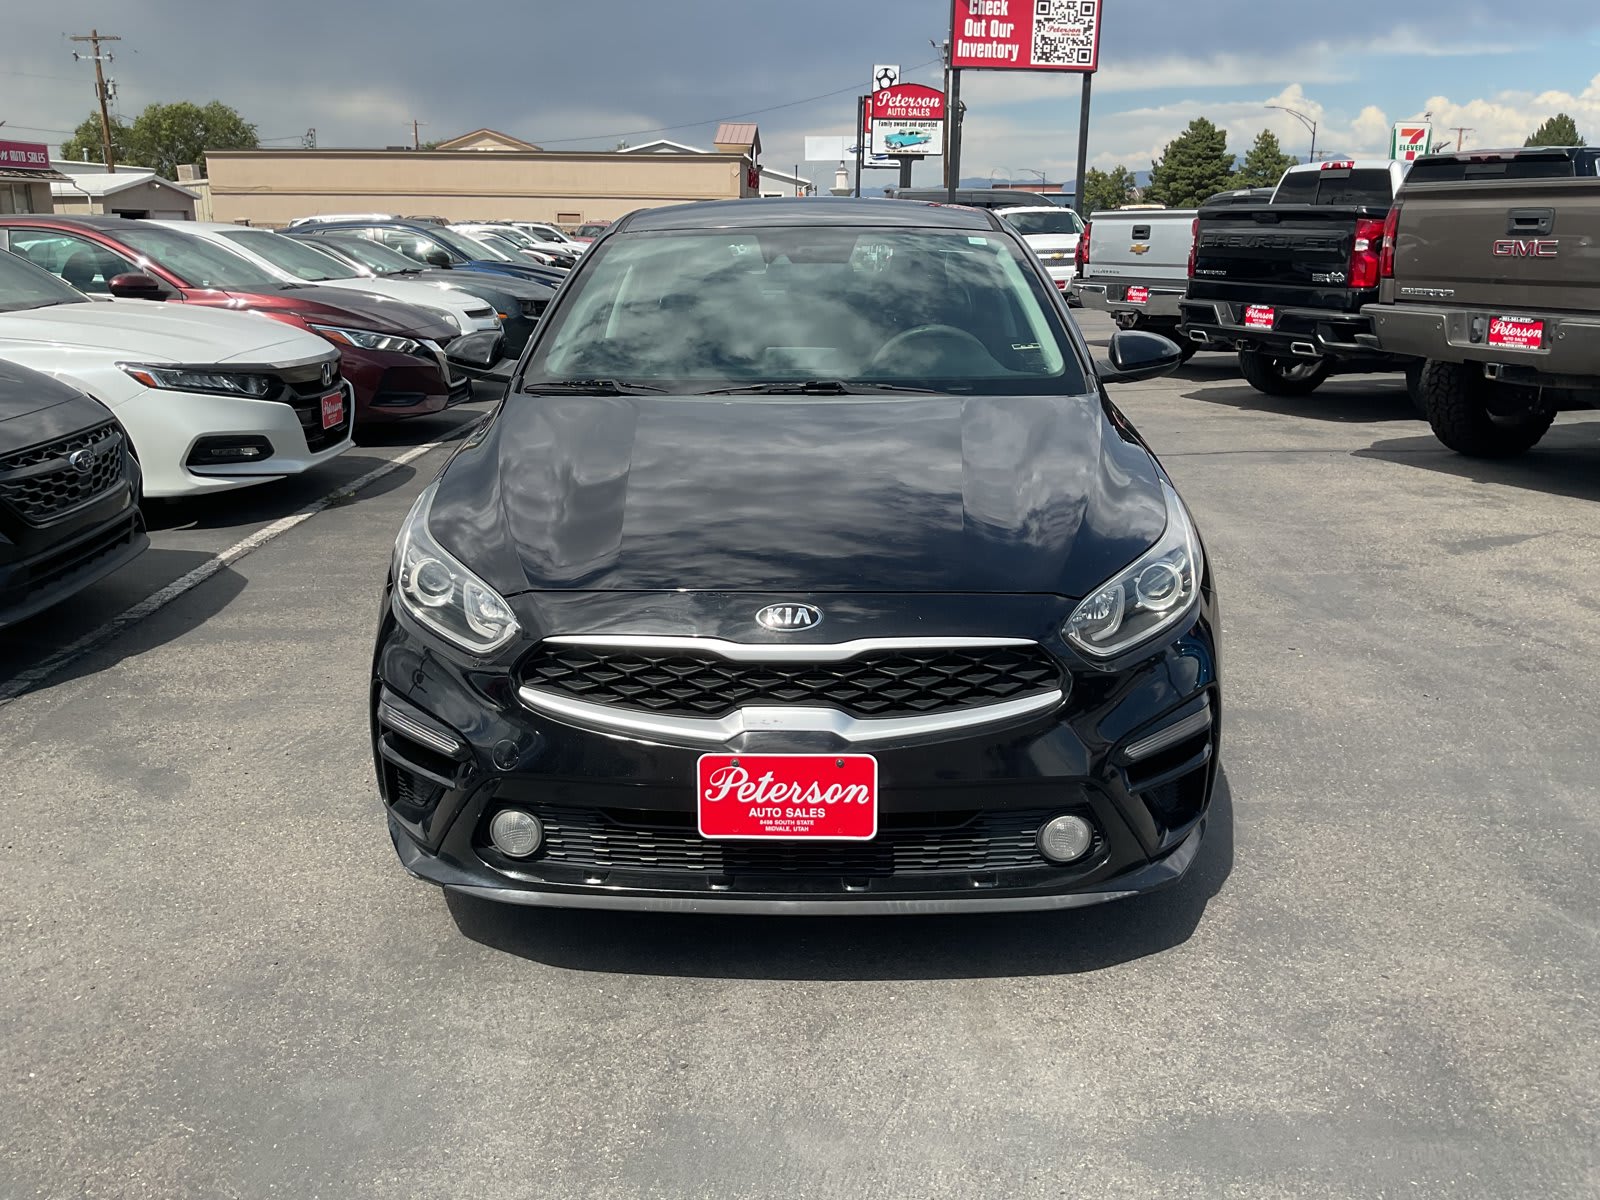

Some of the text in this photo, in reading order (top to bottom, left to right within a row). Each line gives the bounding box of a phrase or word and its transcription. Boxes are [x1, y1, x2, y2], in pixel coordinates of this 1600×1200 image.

[969, 0, 1009, 16] Check
[964, 18, 1015, 39] Out Our
[1046, 25, 1082, 33] Peterson
[957, 39, 1020, 62] Inventory
[876, 91, 941, 108] Peterson
[887, 107, 931, 117] AUTO SALES
[1492, 239, 1559, 258] GMC
[1245, 307, 1274, 320] Peterson
[1490, 320, 1543, 338] Peterson
[765, 607, 812, 625] KIA
[704, 766, 870, 805] Peterson
[748, 807, 826, 818] AUTO SALES
